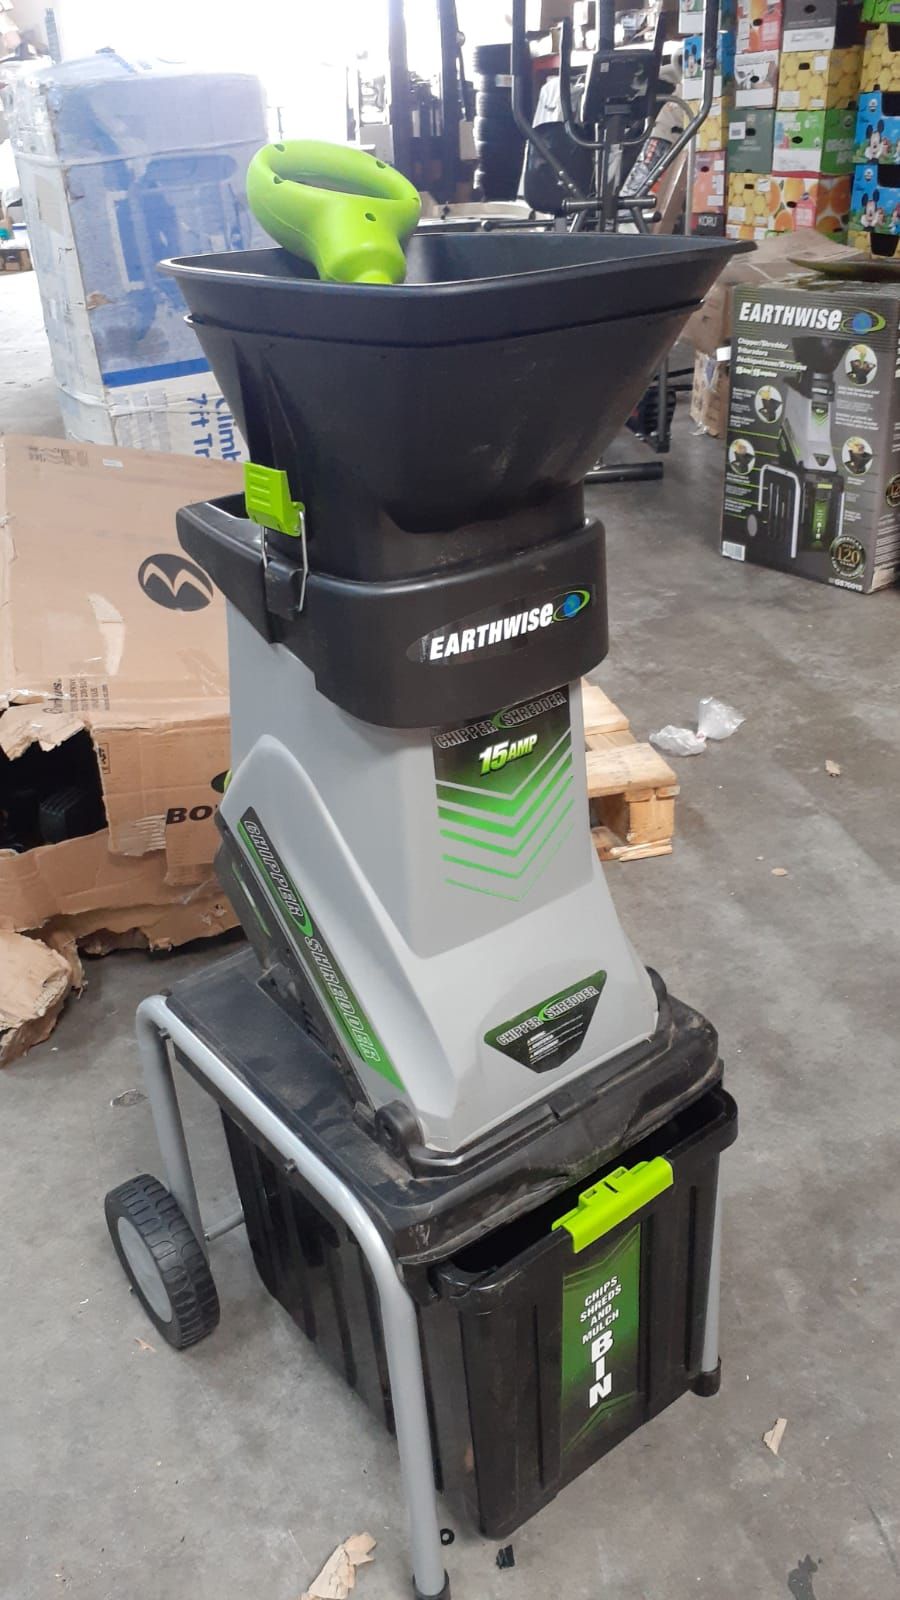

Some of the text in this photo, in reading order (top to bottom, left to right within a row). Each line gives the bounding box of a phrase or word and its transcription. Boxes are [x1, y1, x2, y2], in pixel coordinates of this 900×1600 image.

[434, 691, 567, 749] CHIPPER SHREDDER
[166, 804, 218, 825] BO
[243, 820, 380, 1062] CHIPPER SHREDDER
[495, 985, 600, 1046] CHIPPER SHREDDER
[579, 1283, 622, 1323] SHREDS
[584, 1275, 618, 1307] CHIPS
[582, 1308, 619, 1345] MULCH
[590, 1303, 612, 1327] AND
